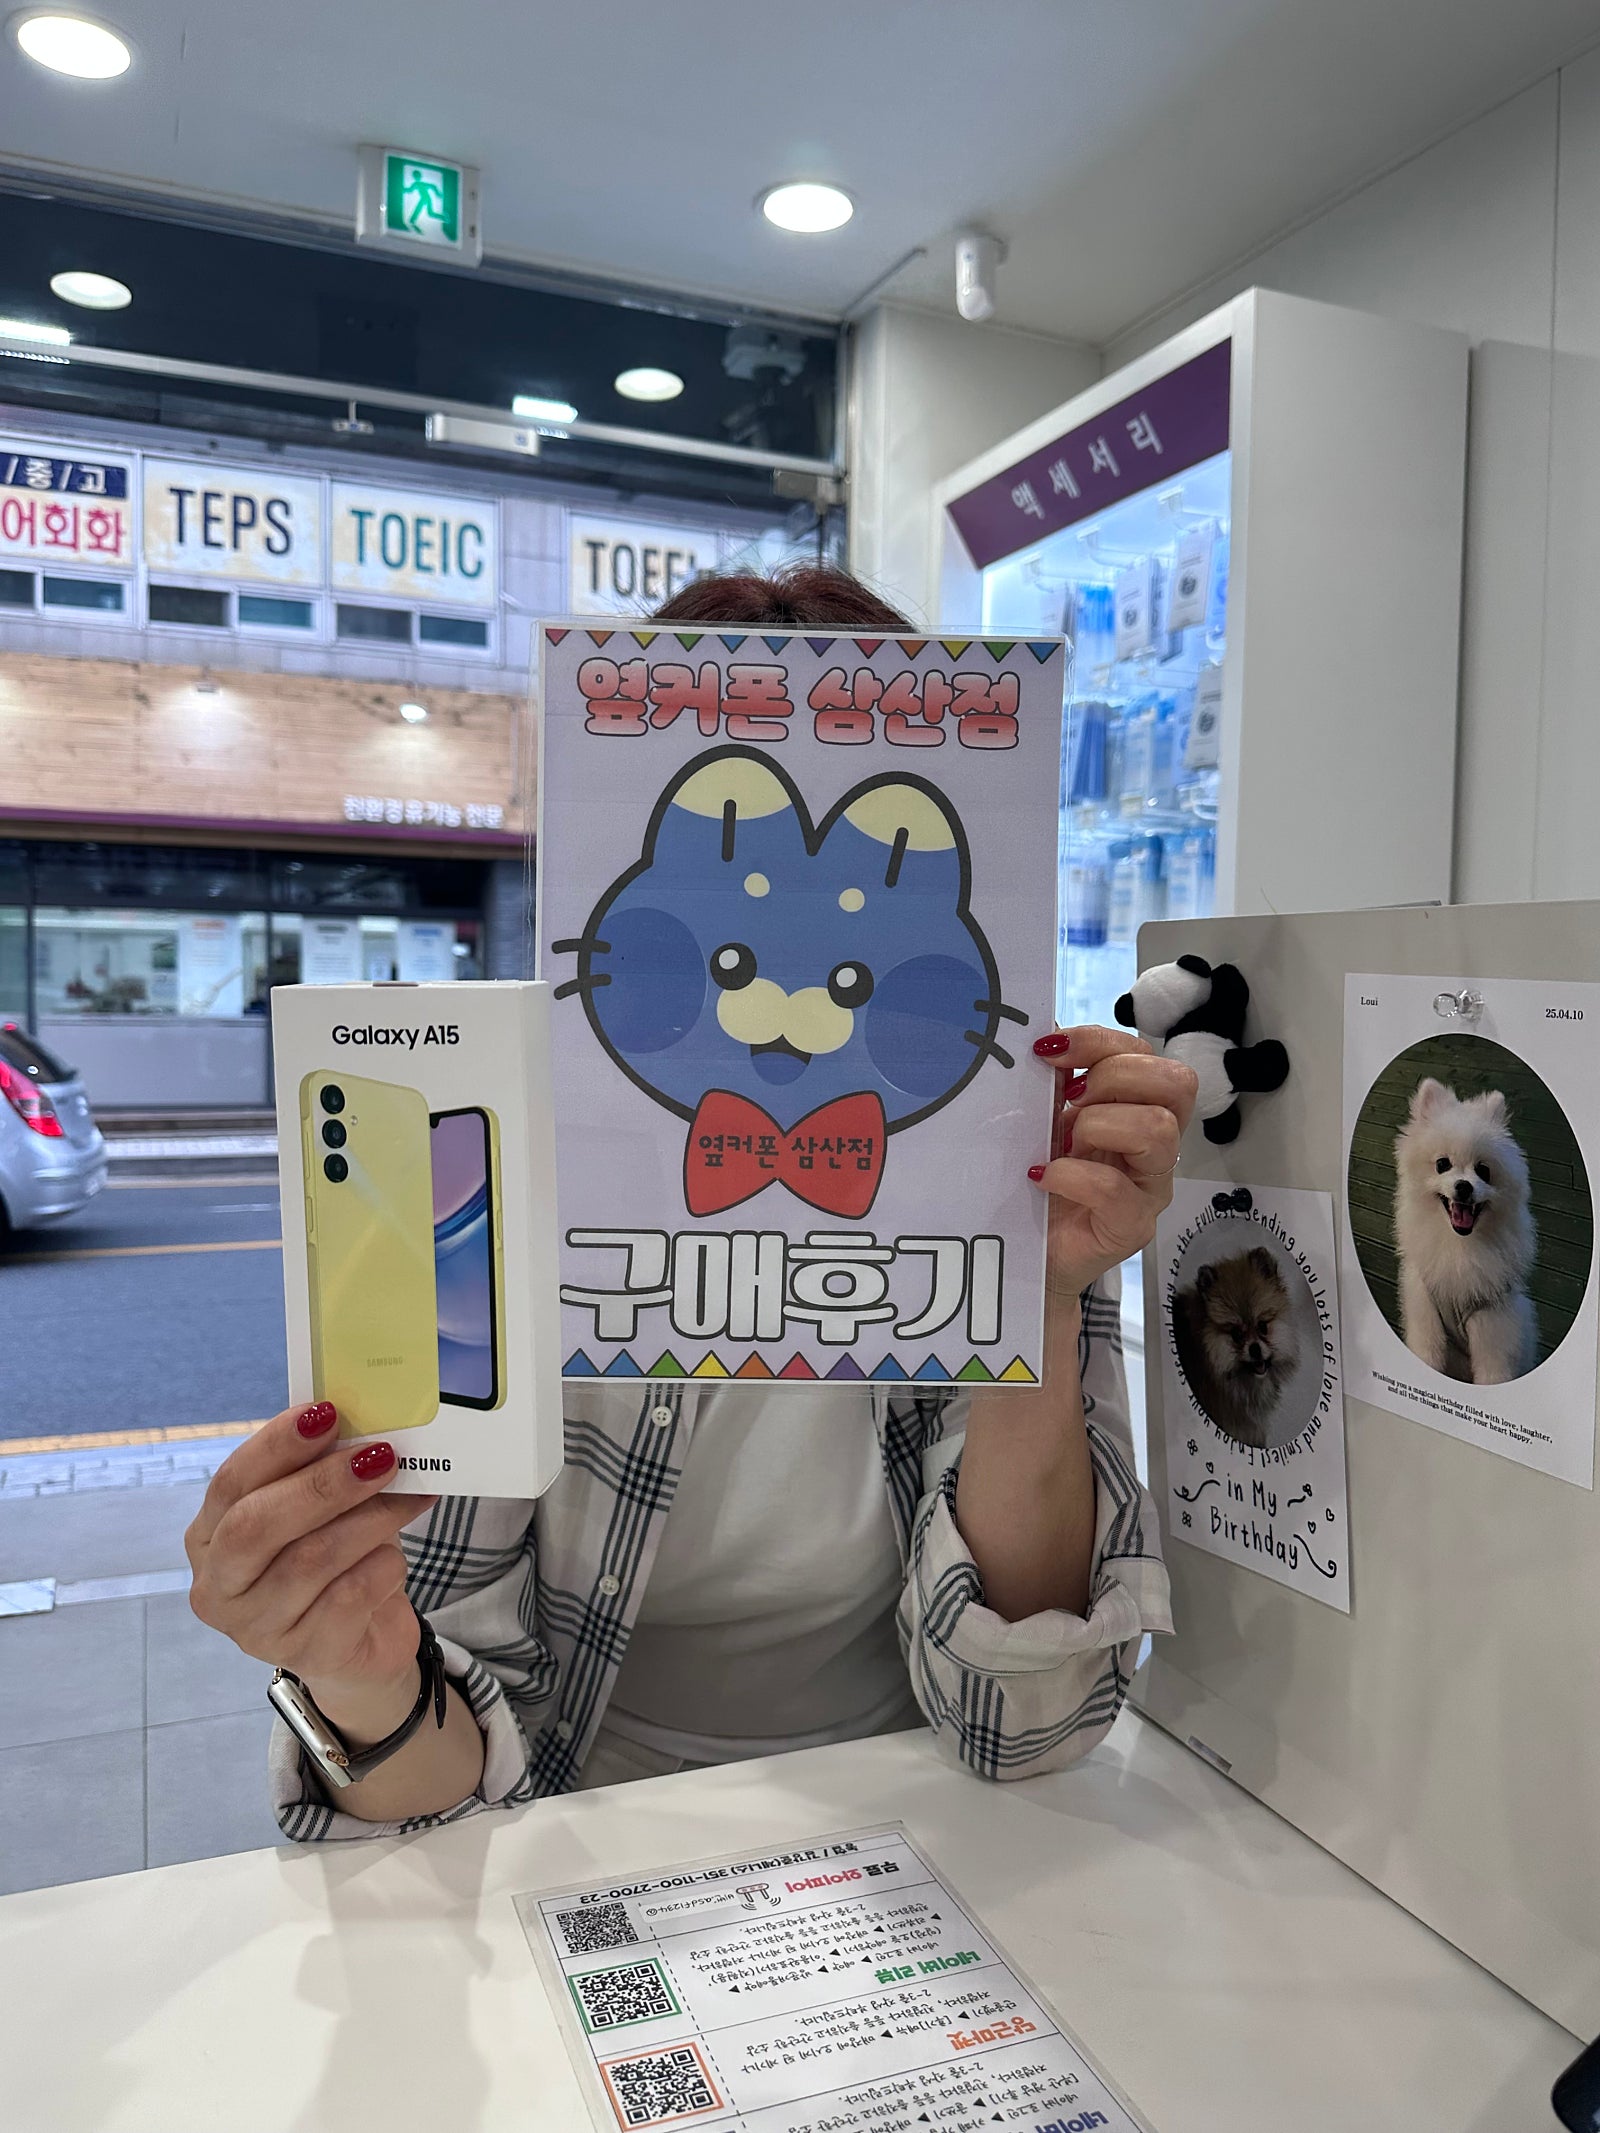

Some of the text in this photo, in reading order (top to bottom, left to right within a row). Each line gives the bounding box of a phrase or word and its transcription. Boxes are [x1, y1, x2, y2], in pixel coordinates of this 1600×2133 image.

[1011, 410, 1164, 520] 액세서리
[170, 487, 291, 556] TEPS
[350, 509, 484, 578] TOEIC
[577, 656, 1020, 750] 옆커폰 삼산점
[1360, 997, 1378, 1006] Loui
[1545, 1008, 1584, 1021] 25.04.10
[332, 1025, 460, 1050] Galaxy A15
[699, 1134, 873, 1170] 옆커폰 삼산점
[1176, 1227, 1194, 1255] the
[1169, 1259, 1180, 1277] to
[1295, 1252, 1317, 1284] you
[560, 1228, 1004, 1345] 구매후기
[1314, 1289, 1333, 1332] lots
[367, 1356, 403, 1367] SAMSUNG
[1322, 1341, 1336, 1366] of
[1320, 1371, 1338, 1412] love
[1372, 1370, 1396, 1386] Wishing
[1396, 1380, 1407, 1390] you
[1413, 1386, 1436, 1401] magical
[1437, 1393, 1464, 1411] birthday
[1465, 1404, 1483, 1418] filled
[1485, 1411, 1500, 1424] with
[1388, 1385, 1533, 1445] and all the things that make your heart happy.
[1303, 1415, 1322, 1452] and
[397, 1457, 452, 1471] MSUNG
[1226, 1472, 1277, 1518] in My
[1210, 1505, 1299, 1570] Birthday
[831, 1843, 858, 1855] 농협
[580, 1869, 729, 1904] 351-1100-2700-23
[785, 1861, 899, 1893] 무료 와이파이
[740, 1916, 807, 1935] 부탁드립니다.
[809, 1911, 833, 1922] 작성
[887, 1917, 926, 1931] 리뷰쓰기
[690, 1903, 928, 1961] 친절하다 등등 솔직하고 등등 솔직하고 간단한 소감
[833, 1930, 869, 1943] 매장에
[799, 1937, 830, 1950] 오시게
[843, 1938, 887, 1954] 예약하기
[692, 1957, 744, 1972] 저렴하다,
[744, 1942, 939, 1991] 네이버 로그인 예약 방문개통예약
[874, 1951, 981, 1984] 네이버 리뷰
[870, 1997, 897, 2011] 작성
[746, 1992, 991, 2057] 저렴하다, 친절하다 등등 솔직하고 간단한 소감
[795, 2004, 868, 2026] 부탁드립니다.
[836, 2036, 876, 2051] 매장에
[946, 2017, 1037, 2050] 당근마켓
[798, 2044, 832, 2060] 오시게
[919, 2072, 947, 2087] 작성
[991, 2064, 1047, 2084] 저렴하다,
[1047, 2073, 1079, 2089] [부산
[838, 2079, 917, 2105] 부탁드립니다.
[913, 2092, 936, 2107] 등등
[938, 2079, 989, 2099] 친절하다
[988, 2089, 1018, 2105] 후기]
[860, 2099, 908, 2119] 솔직하고
[1006, 2103, 1040, 2120] 로그인
[1041, 2094, 1078, 2110] 네이버
[817, 2113, 859, 2132] 간단한
